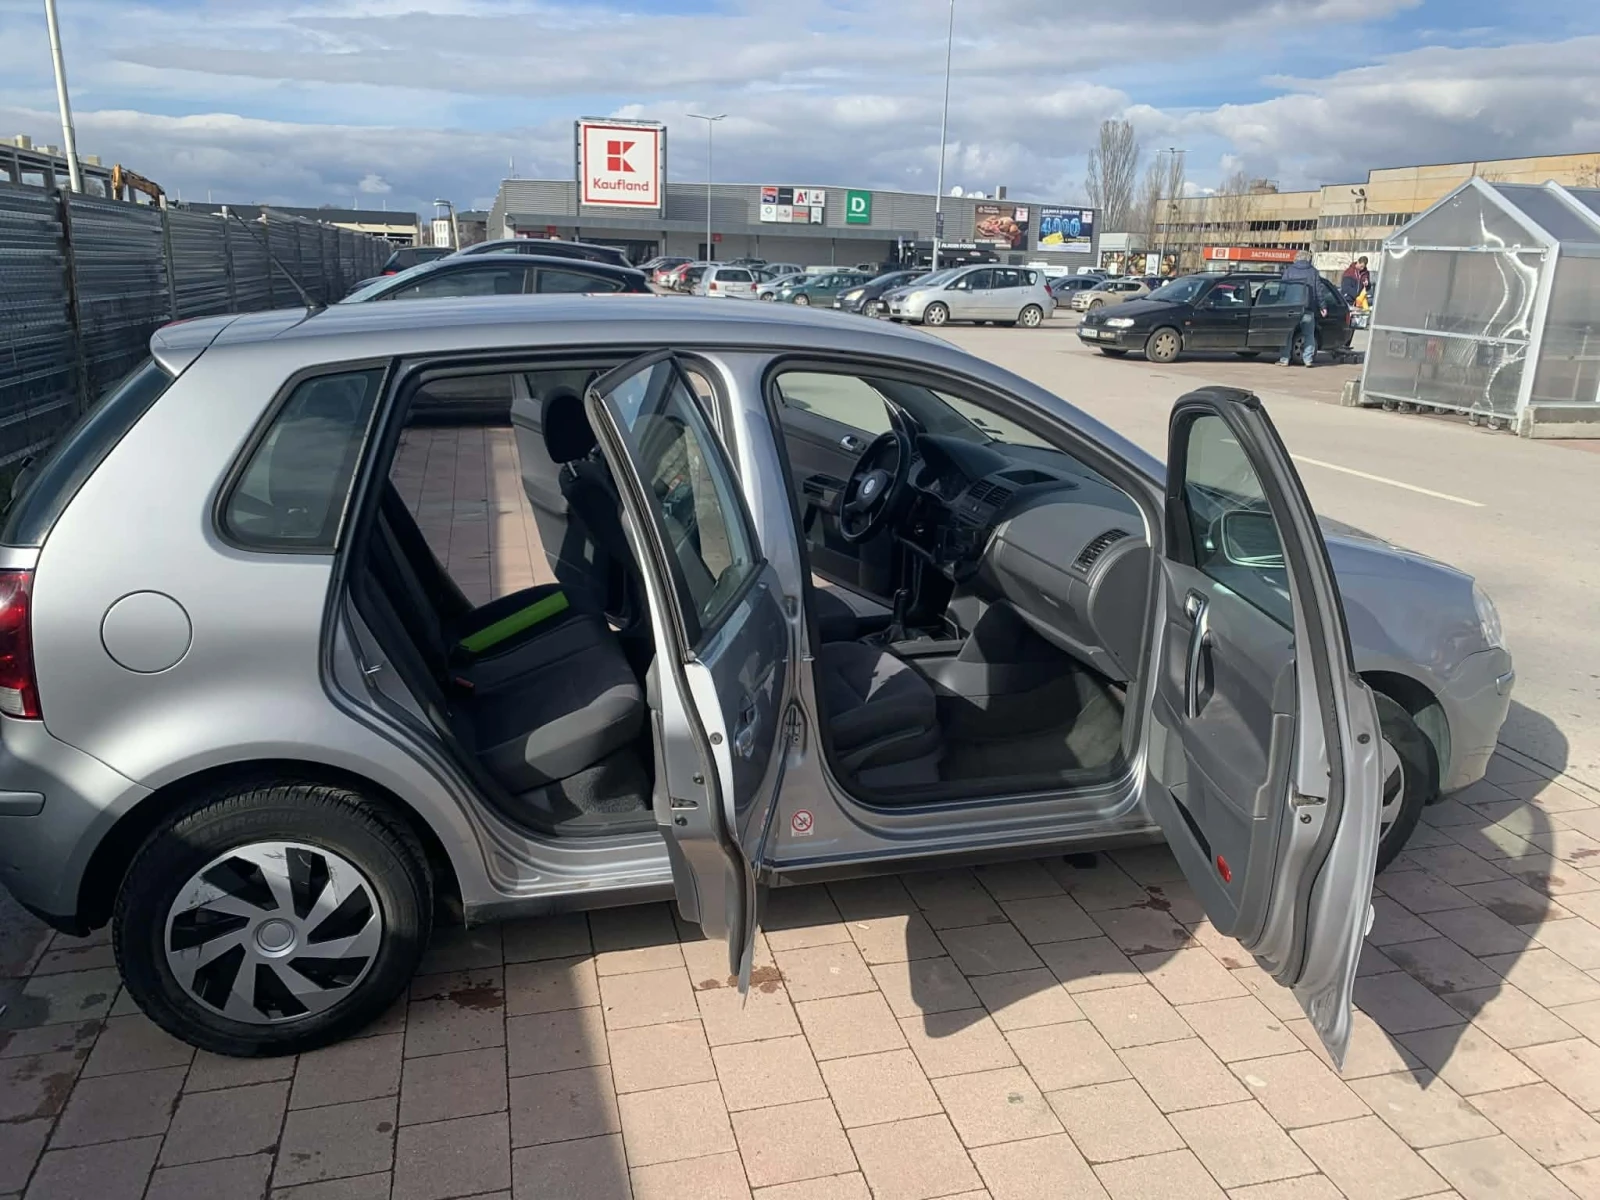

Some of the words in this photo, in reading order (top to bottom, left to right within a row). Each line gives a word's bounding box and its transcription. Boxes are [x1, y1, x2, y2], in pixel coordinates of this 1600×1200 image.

[593, 178, 649, 192] Kaufland
[852, 197, 865, 212] D
[1041, 217, 1080, 236] 4000
